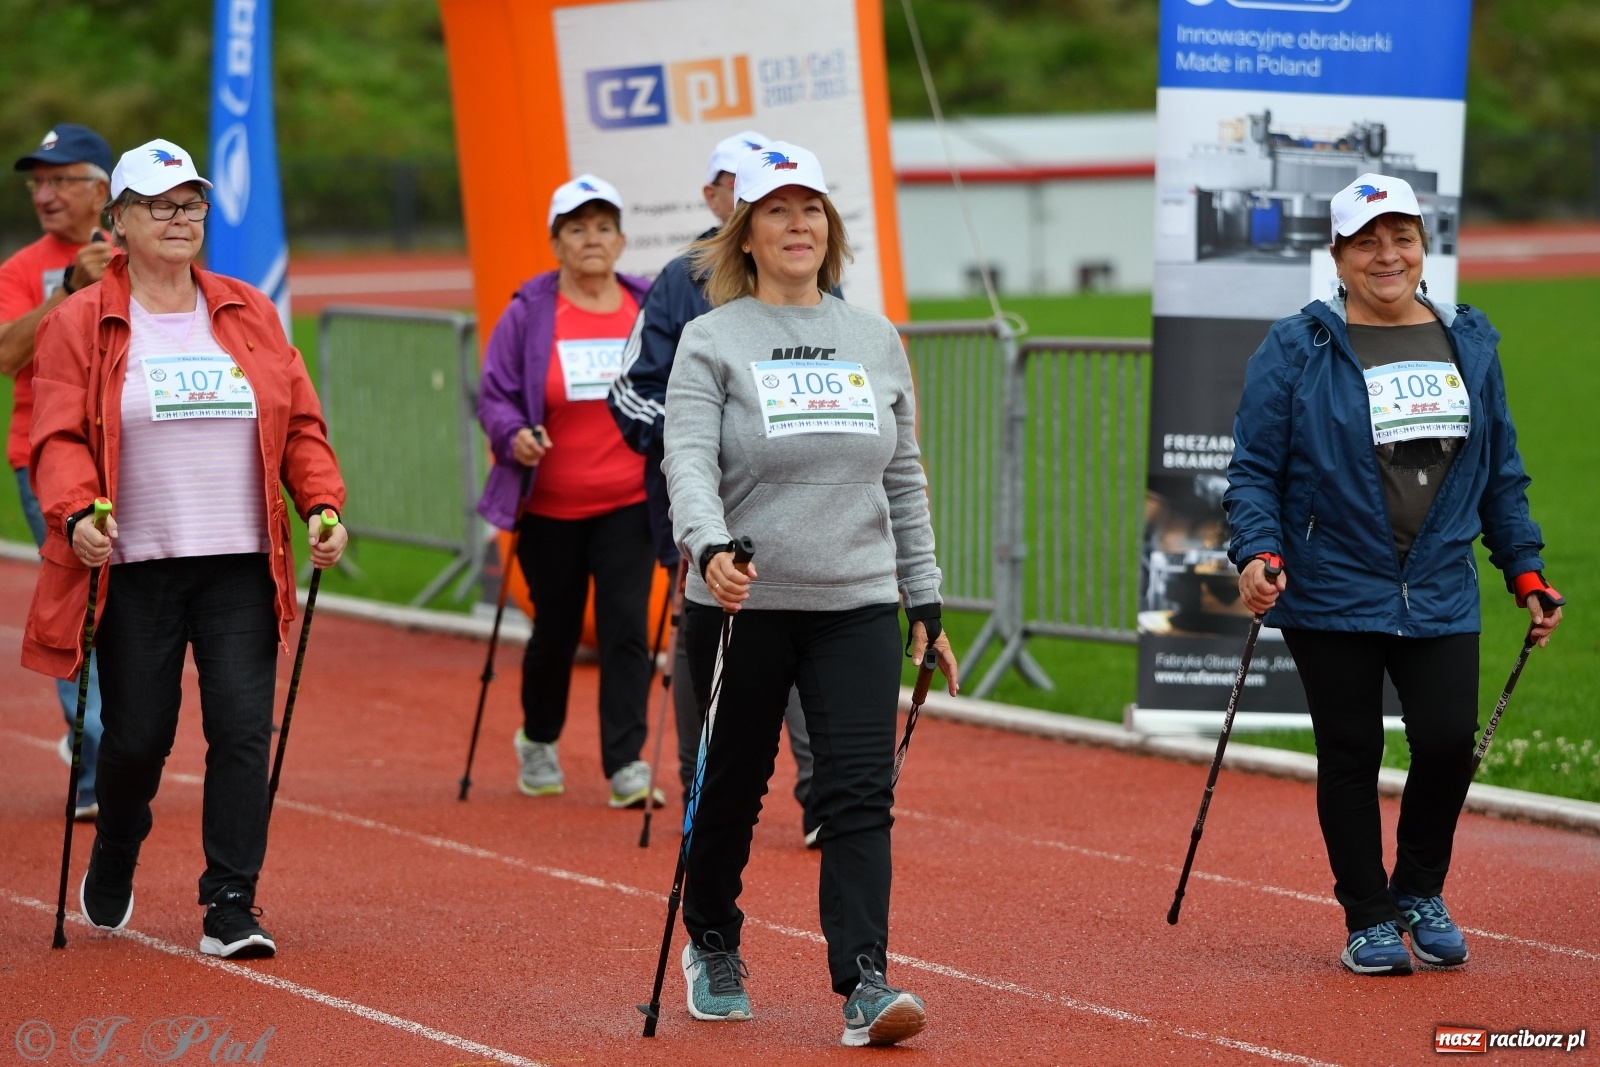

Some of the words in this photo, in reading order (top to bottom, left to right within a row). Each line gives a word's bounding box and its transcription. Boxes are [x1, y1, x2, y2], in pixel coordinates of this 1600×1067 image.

[1176, 23, 1296, 52] Innowacyjne
[1297, 28, 1393, 53] obrabiarki
[1175, 51, 1232, 74] Made
[1234, 53, 1254, 74] in
[1256, 52, 1322, 77] Poland
[771, 345, 837, 361] NIKE
[175, 370, 223, 392] 107
[787, 372, 843, 395] 106
[1390, 374, 1442, 400] 108
[1155, 652, 1203, 671] Fabryka
